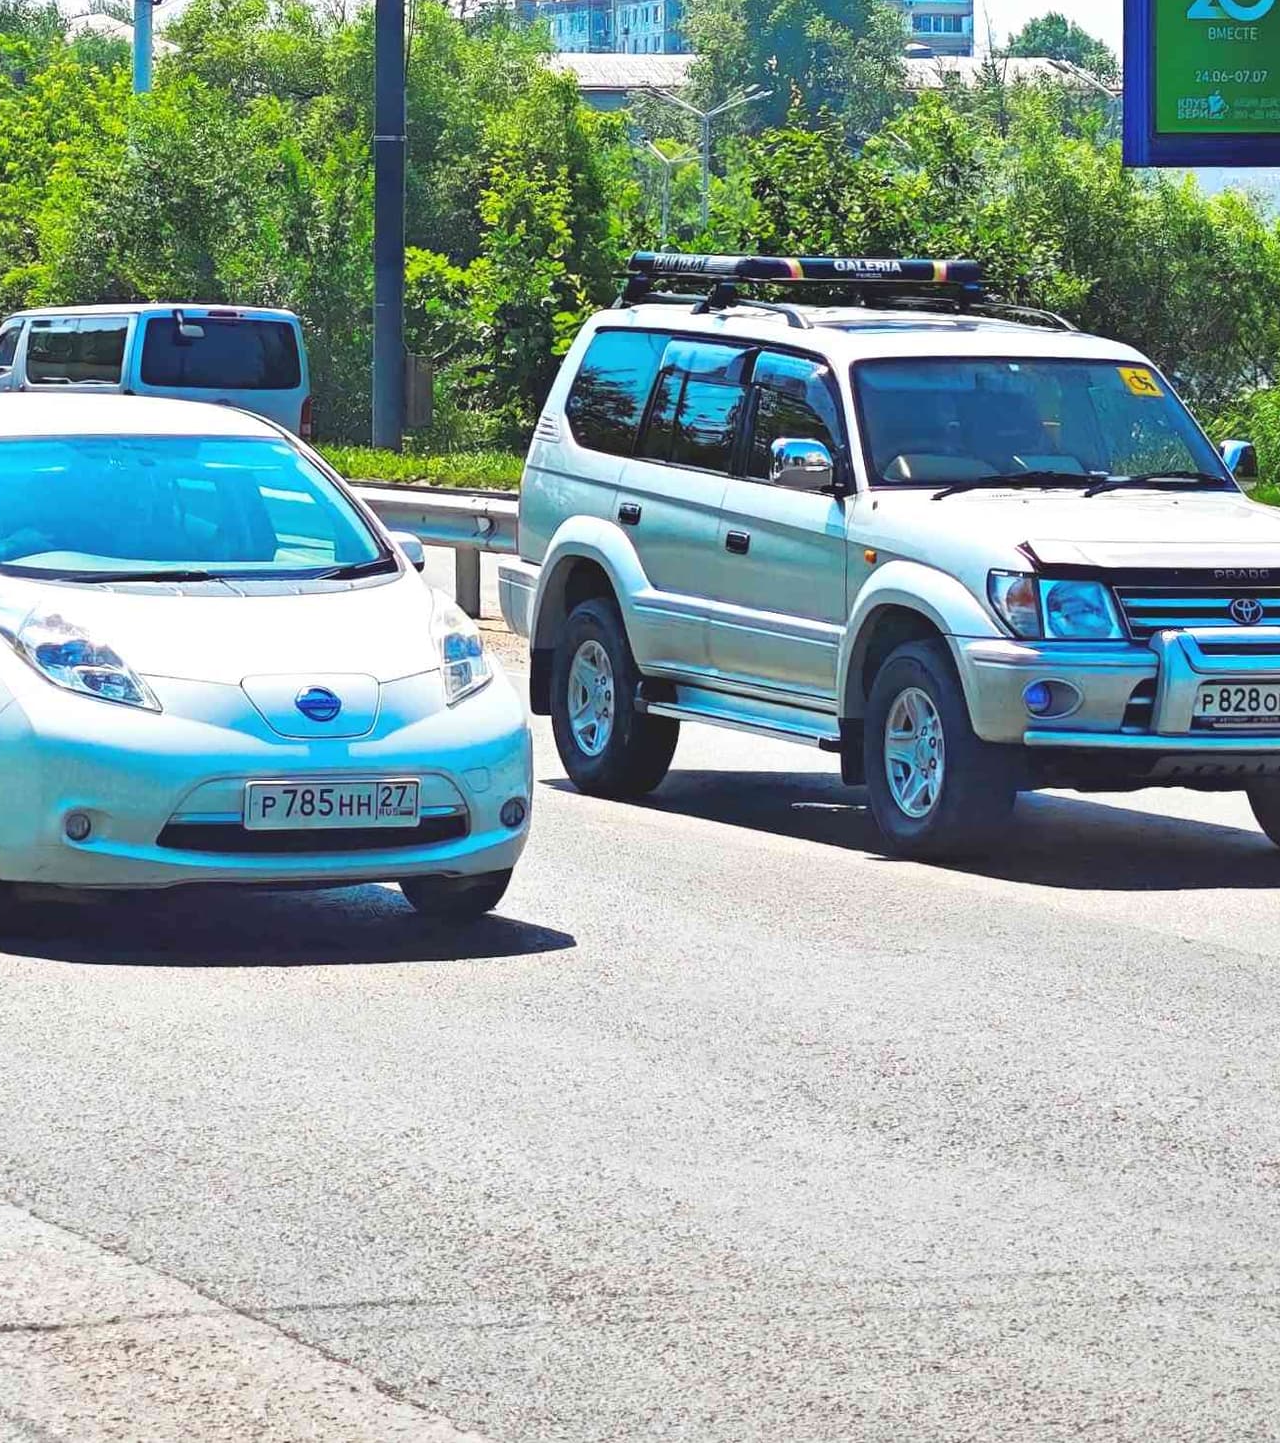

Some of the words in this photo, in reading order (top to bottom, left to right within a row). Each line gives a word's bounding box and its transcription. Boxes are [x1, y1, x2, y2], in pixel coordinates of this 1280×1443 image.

[1207, 26, 1259, 41] ВМЕСТЕ
[1177, 97, 1209, 109] КЛУБ
[1213, 568, 1271, 580] PRADO
[379, 785, 408, 808] 27
